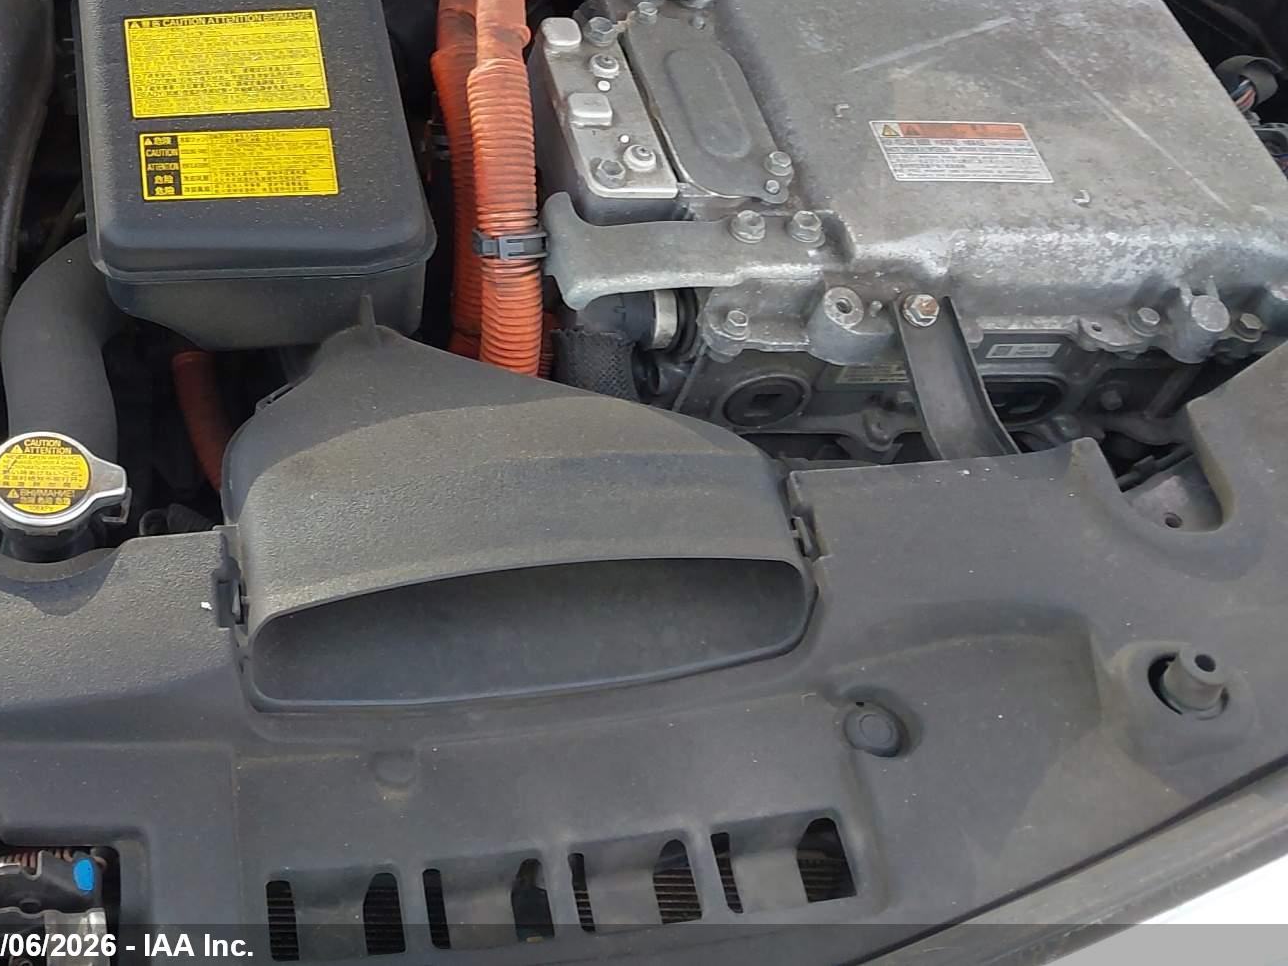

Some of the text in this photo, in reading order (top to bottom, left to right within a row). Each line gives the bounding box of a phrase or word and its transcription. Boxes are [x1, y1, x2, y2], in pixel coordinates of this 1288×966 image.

[162, 17, 206, 27] CAUTION
[207, 14, 263, 25] ATTENTION
[145, 148, 178, 157] CAUTION
[23, 439, 61, 447] CAUTION
